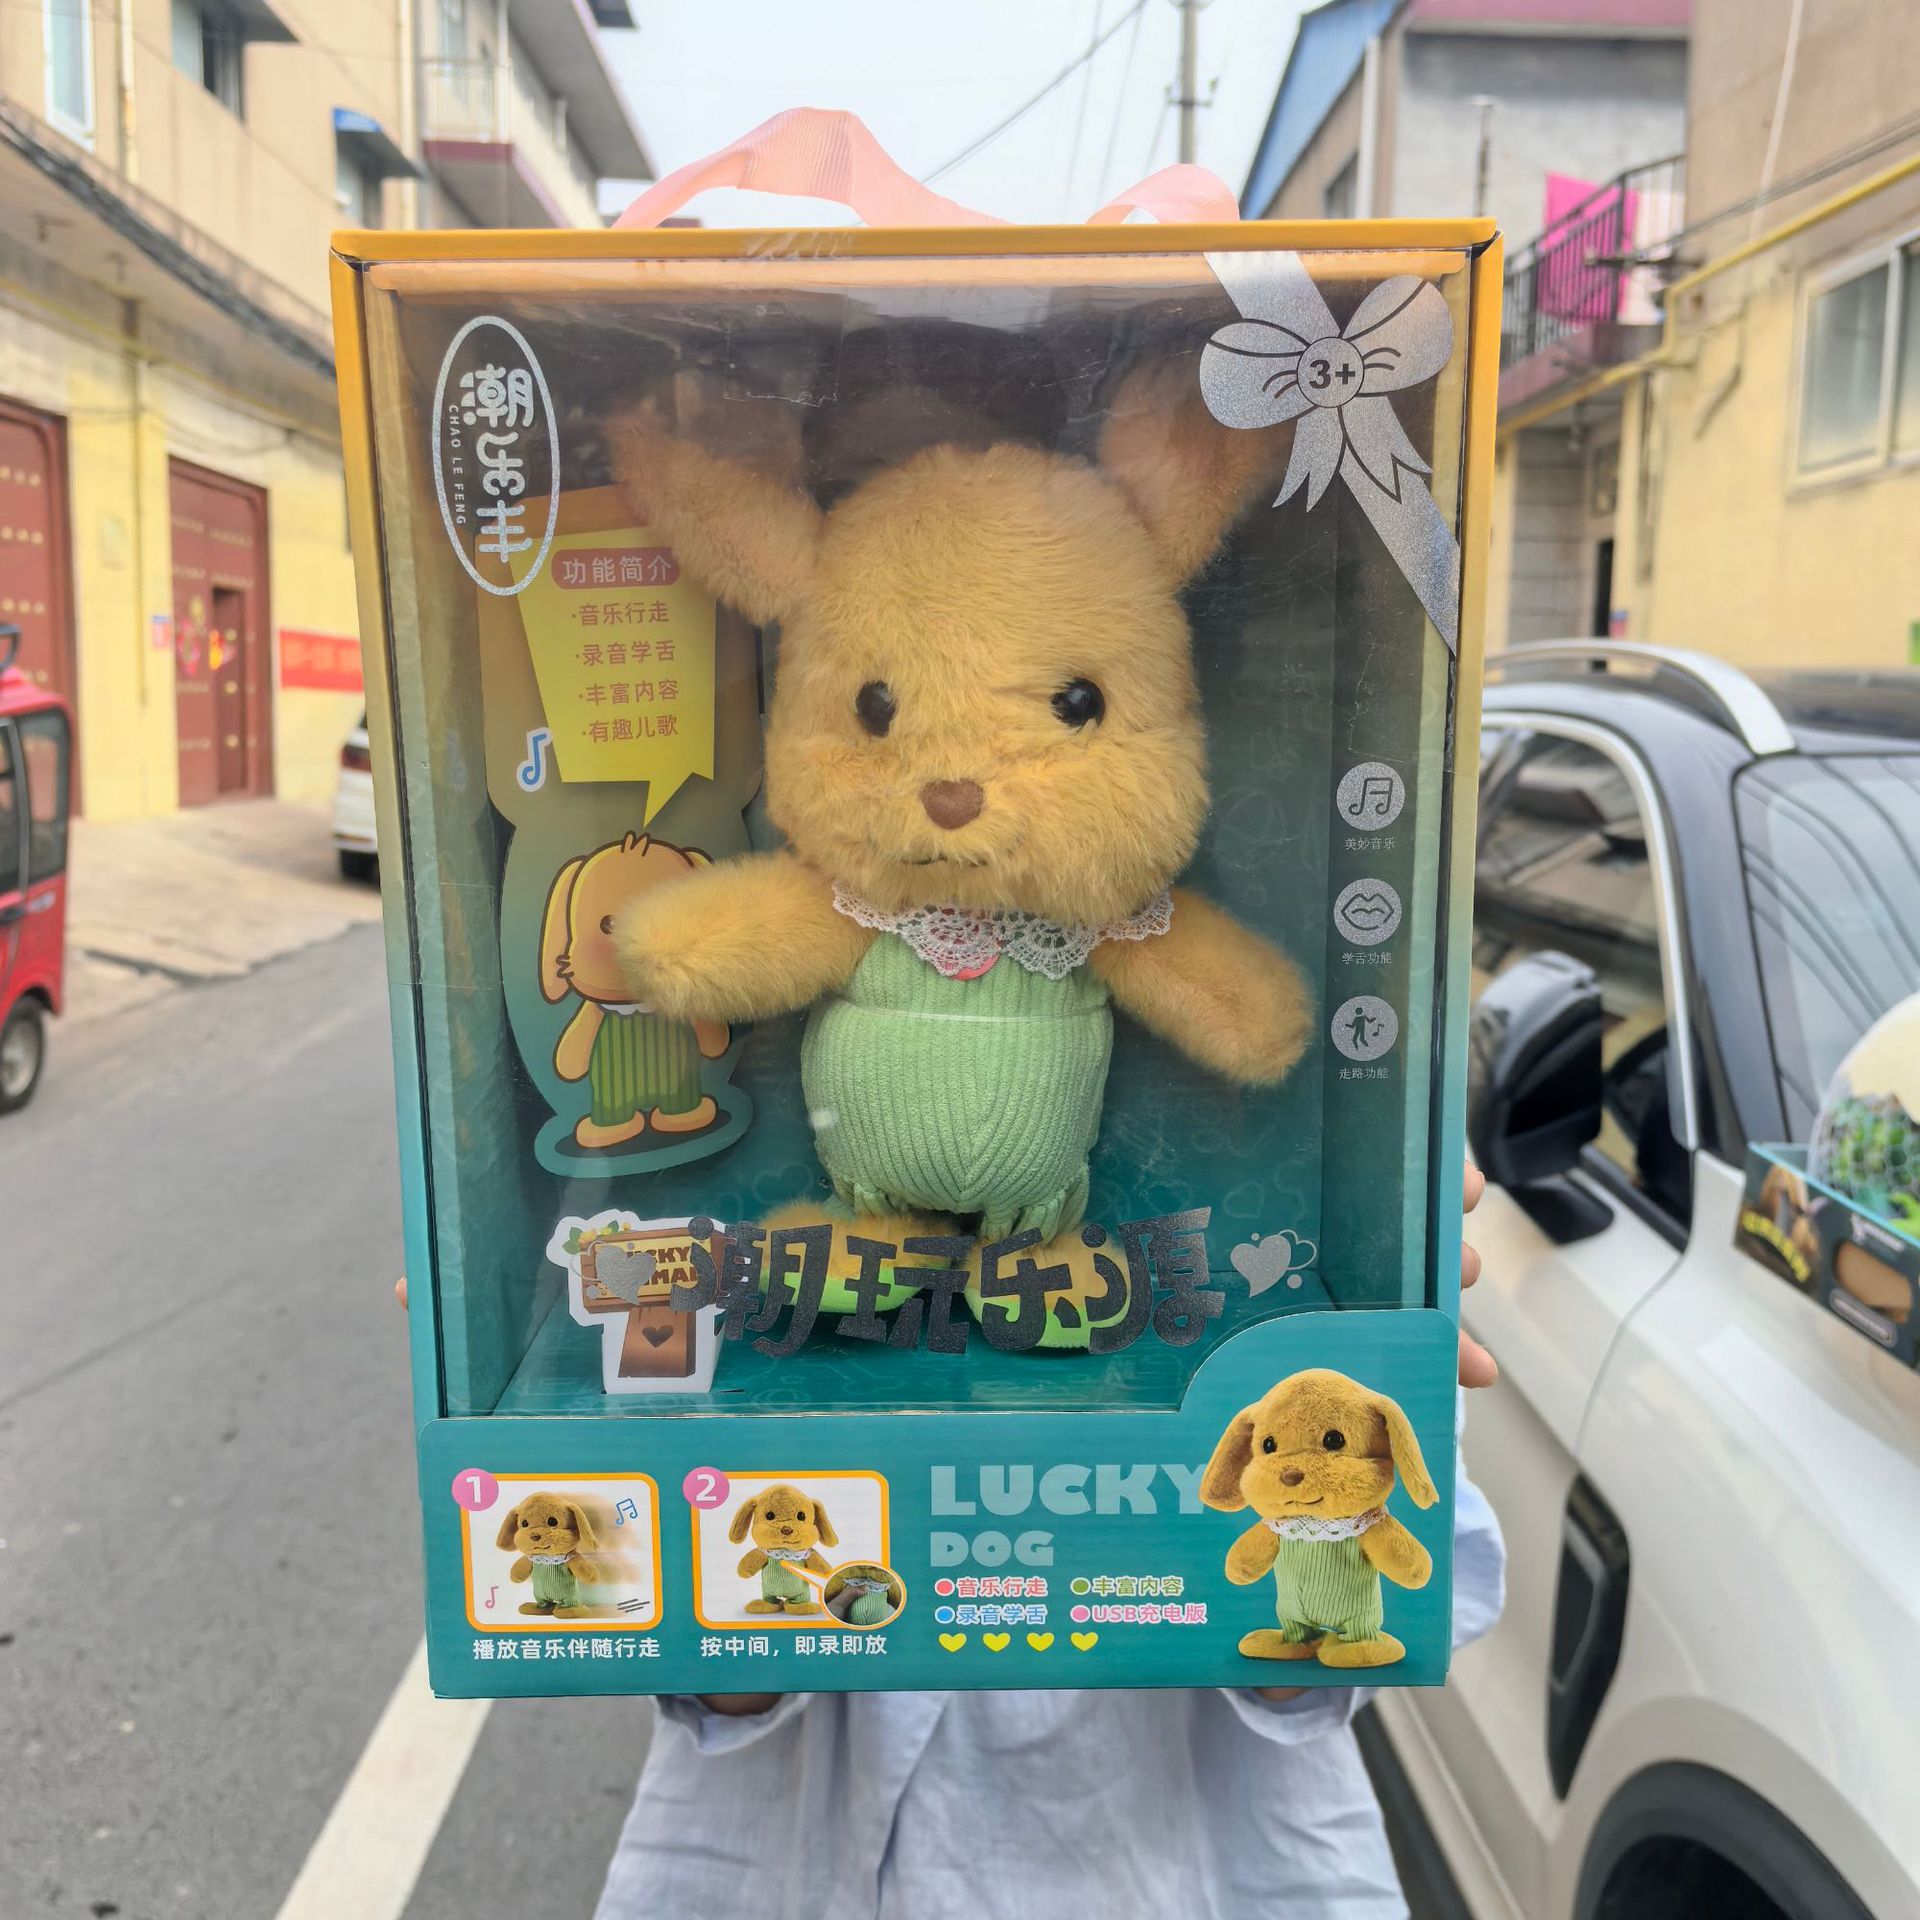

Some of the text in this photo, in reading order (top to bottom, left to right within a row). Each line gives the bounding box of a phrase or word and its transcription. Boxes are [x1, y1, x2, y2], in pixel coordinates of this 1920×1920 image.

[1308, 359, 1356, 390] 3+
[449, 404, 467, 525] CHAO LE FENG
[562, 554, 671, 585] 功能简介
[578, 602, 670, 627] 音乐行走
[582, 640, 676, 667] 录音学舌
[586, 680, 679, 707] 丰富内容
[588, 714, 679, 743] 有趣儿歌
[1345, 837, 1395, 850] 美妙音乐
[1342, 953, 1392, 965] 学舌功能
[1339, 1068, 1389, 1080] 走路功能
[465, 1476, 482, 1503] 1
[696, 1474, 718, 1501] 2
[930, 1464, 1207, 1516] LUCKY
[930, 1530, 1054, 1567] DOG
[956, 1576, 1048, 1598] 音乐行走
[1092, 1576, 1184, 1596] 丰富内容
[956, 1604, 1048, 1625] 录音学舌
[1092, 1602, 1208, 1624] USB充电版
[472, 1637, 661, 1660] 播放音乐伴随行走
